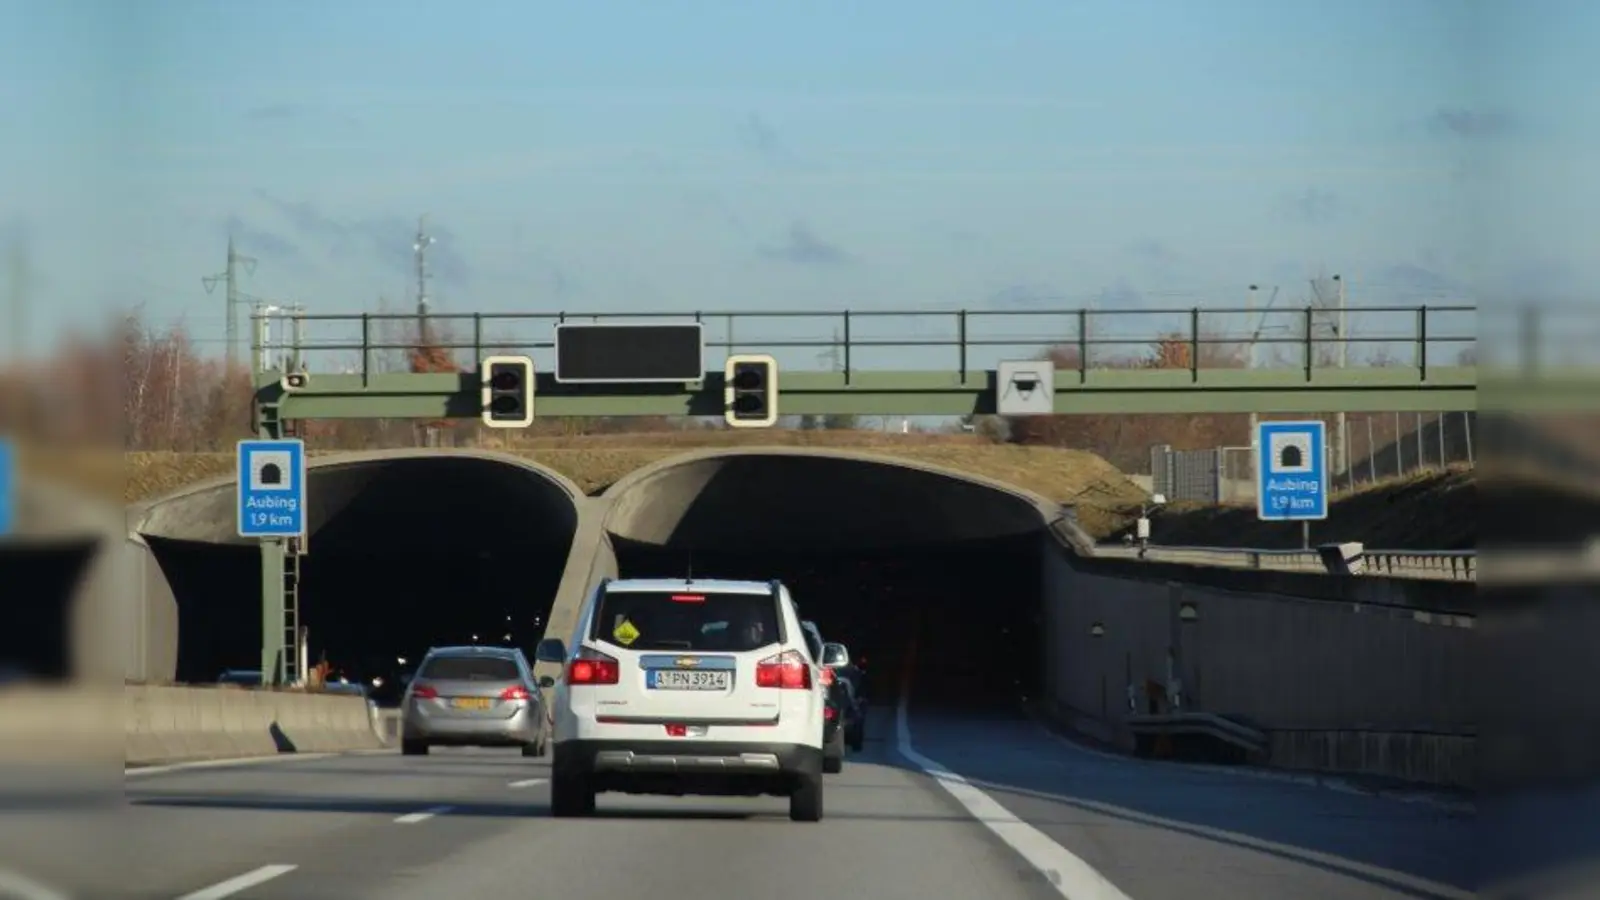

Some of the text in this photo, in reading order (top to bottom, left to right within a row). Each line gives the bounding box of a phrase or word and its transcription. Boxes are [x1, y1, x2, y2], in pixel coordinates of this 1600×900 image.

[1267, 478, 1318, 494] Aubing
[246, 495, 297, 512] Aubing
[1290, 496, 1314, 509] km
[269, 513, 293, 526] km
